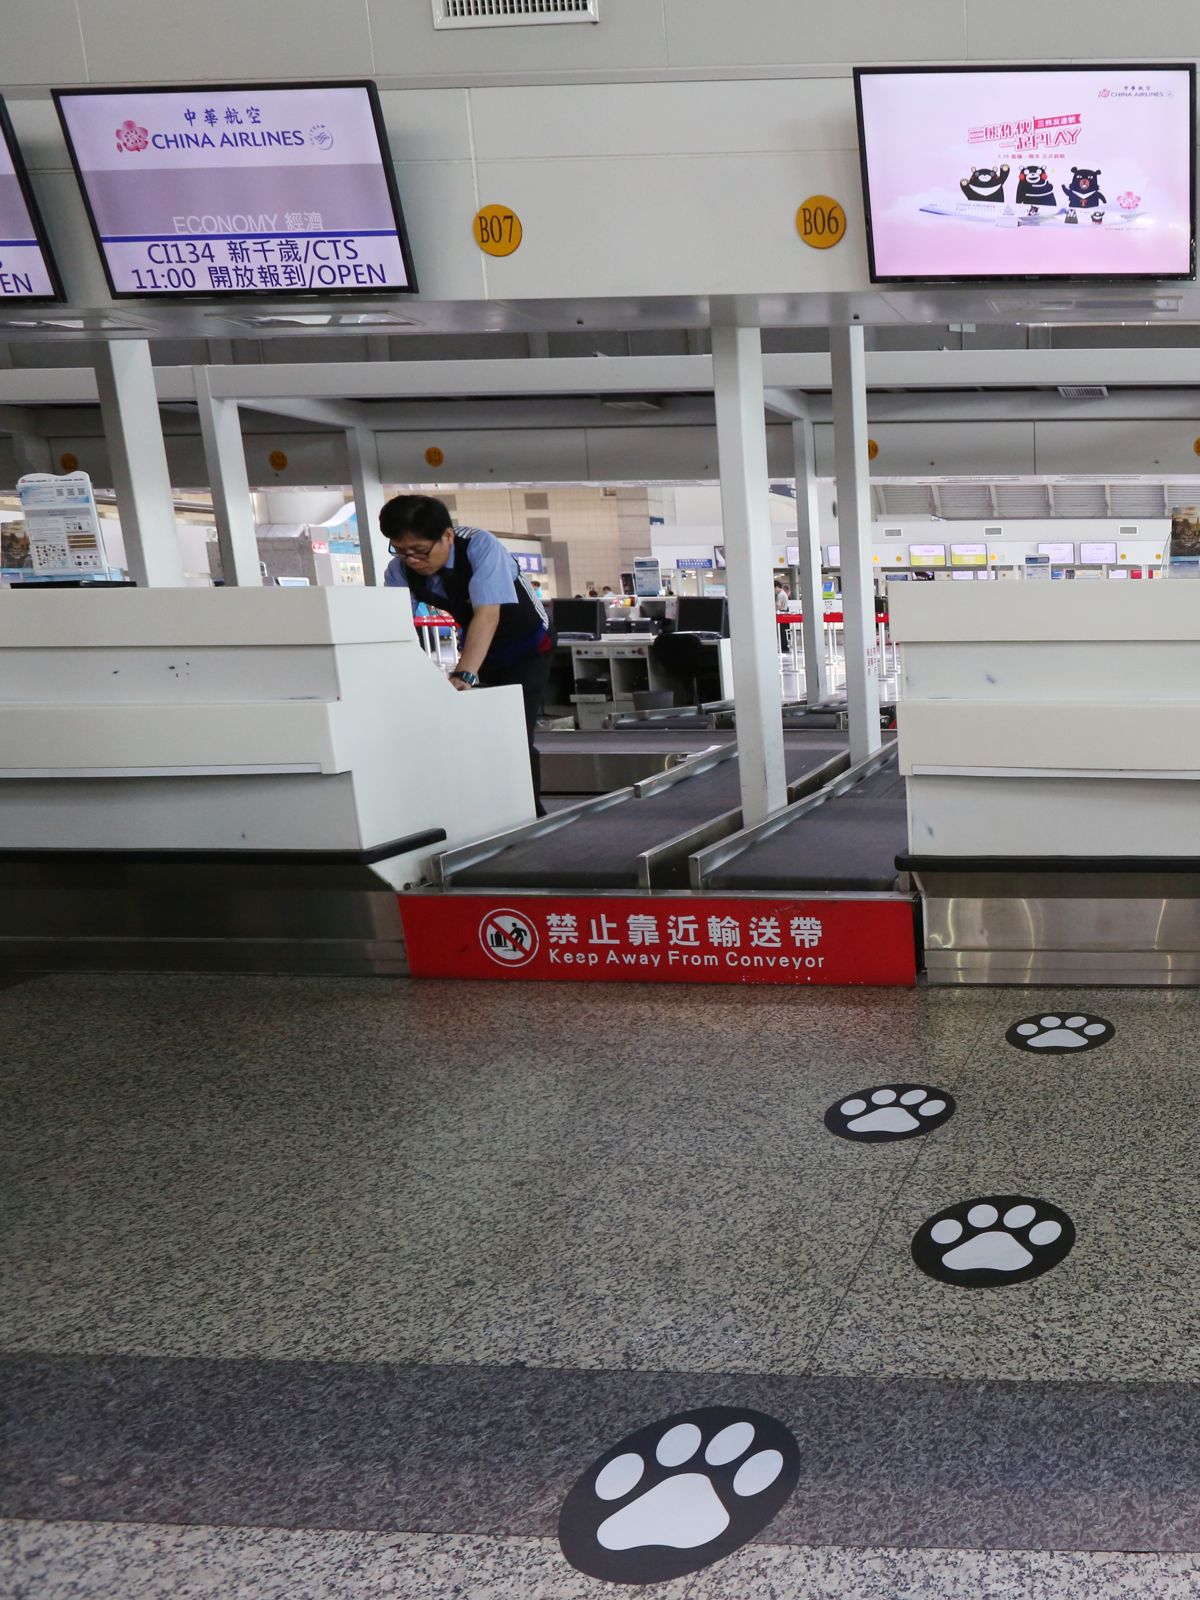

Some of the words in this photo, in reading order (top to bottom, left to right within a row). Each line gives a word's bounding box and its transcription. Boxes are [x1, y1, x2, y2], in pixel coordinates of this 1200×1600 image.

[184, 107, 262, 127] 中華航空
[152, 132, 215, 151] CHINA
[220, 130, 305, 148] AIRLINES
[173, 214, 278, 234] ECONOMY
[285, 211, 323, 232] 經濟
[479, 215, 514, 243] B07
[802, 206, 839, 235] B06
[147, 242, 215, 265] CI134
[228, 240, 358, 264] 新千歲/CTS
[132, 267, 196, 290] 11:00
[209, 264, 386, 290] 開放報到/OPEN
[547, 912, 823, 949] 禁止靠近輸送帶
[549, 948, 598, 966] Keep
[606, 949, 661, 968] Away
[669, 950, 719, 966] From
[725, 951, 825, 969] Conveyor
